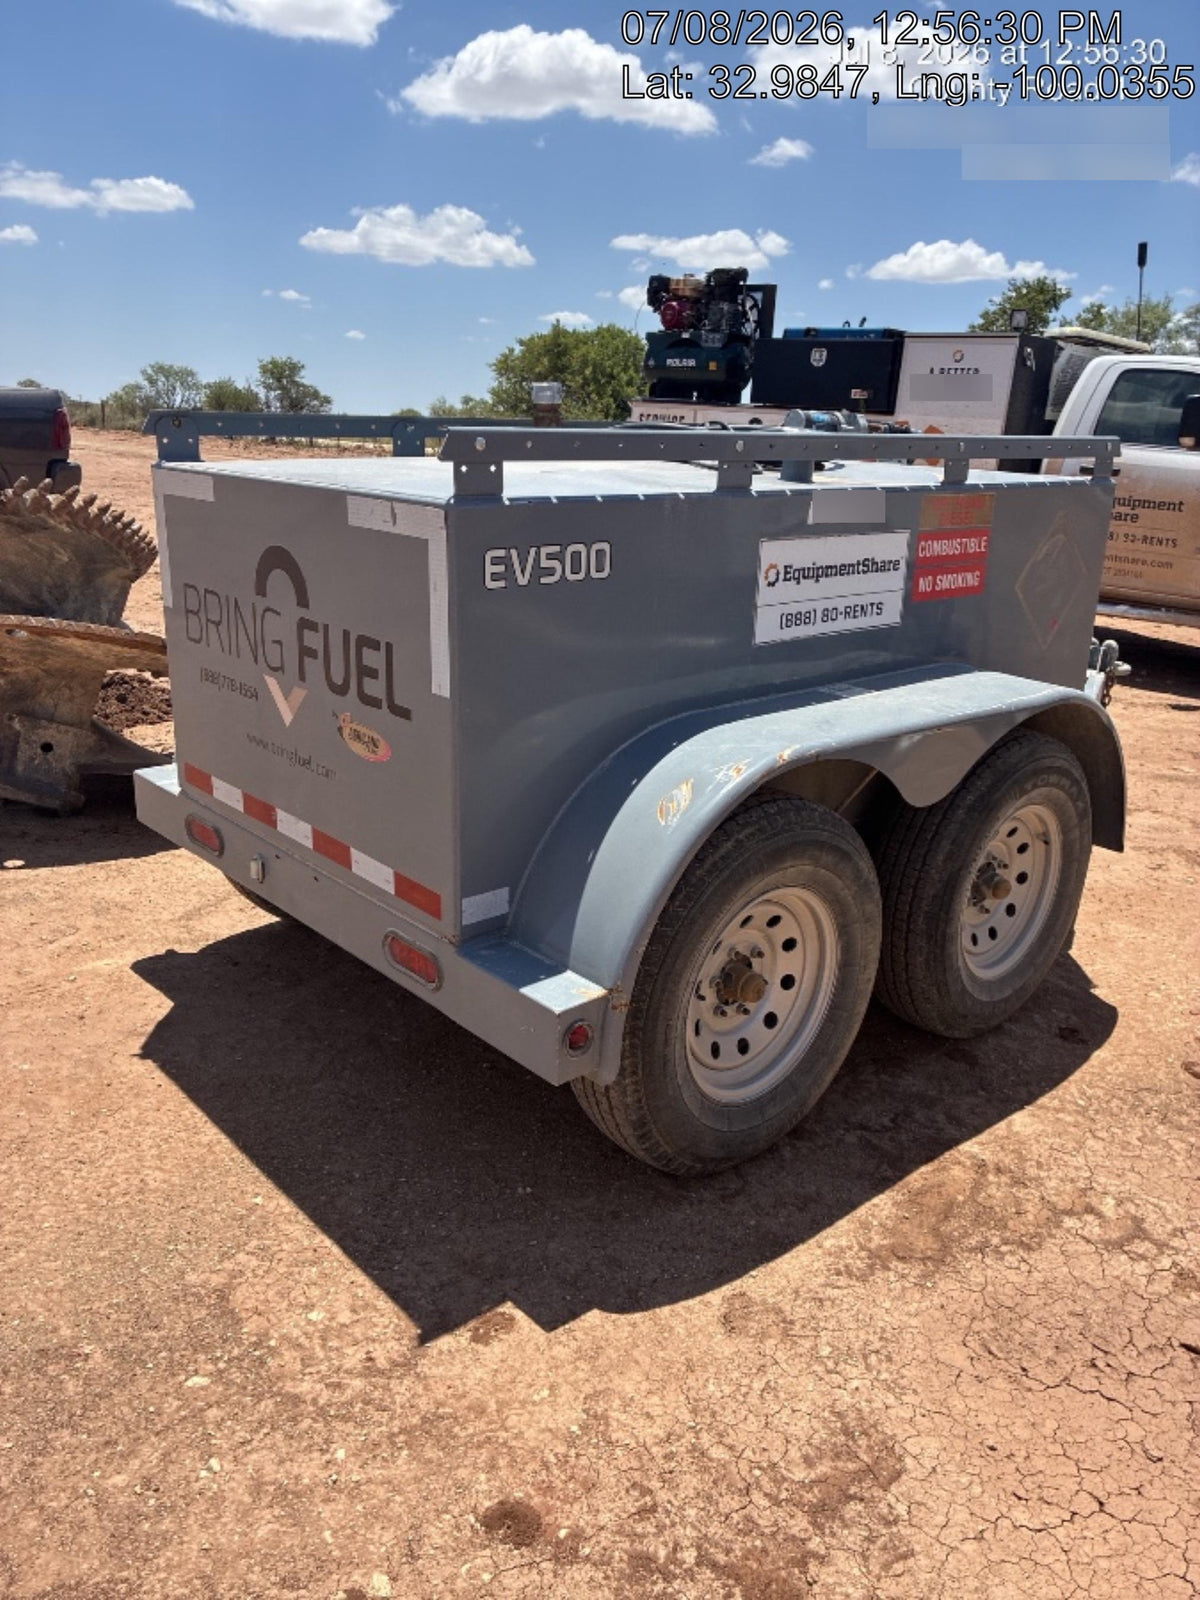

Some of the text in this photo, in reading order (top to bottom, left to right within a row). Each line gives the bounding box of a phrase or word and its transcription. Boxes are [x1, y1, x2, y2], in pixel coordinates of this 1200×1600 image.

[1112, 495, 1185, 513] uipment
[918, 536, 989, 558] COMBUSTIBLE
[483, 540, 612, 591] EV500
[782, 556, 901, 586] EquipmentShare
[918, 570, 981, 593] NO SMOKING
[780, 601, 885, 631] (888) 80-RENTS
[183, 582, 412, 721] BRING FUEL
